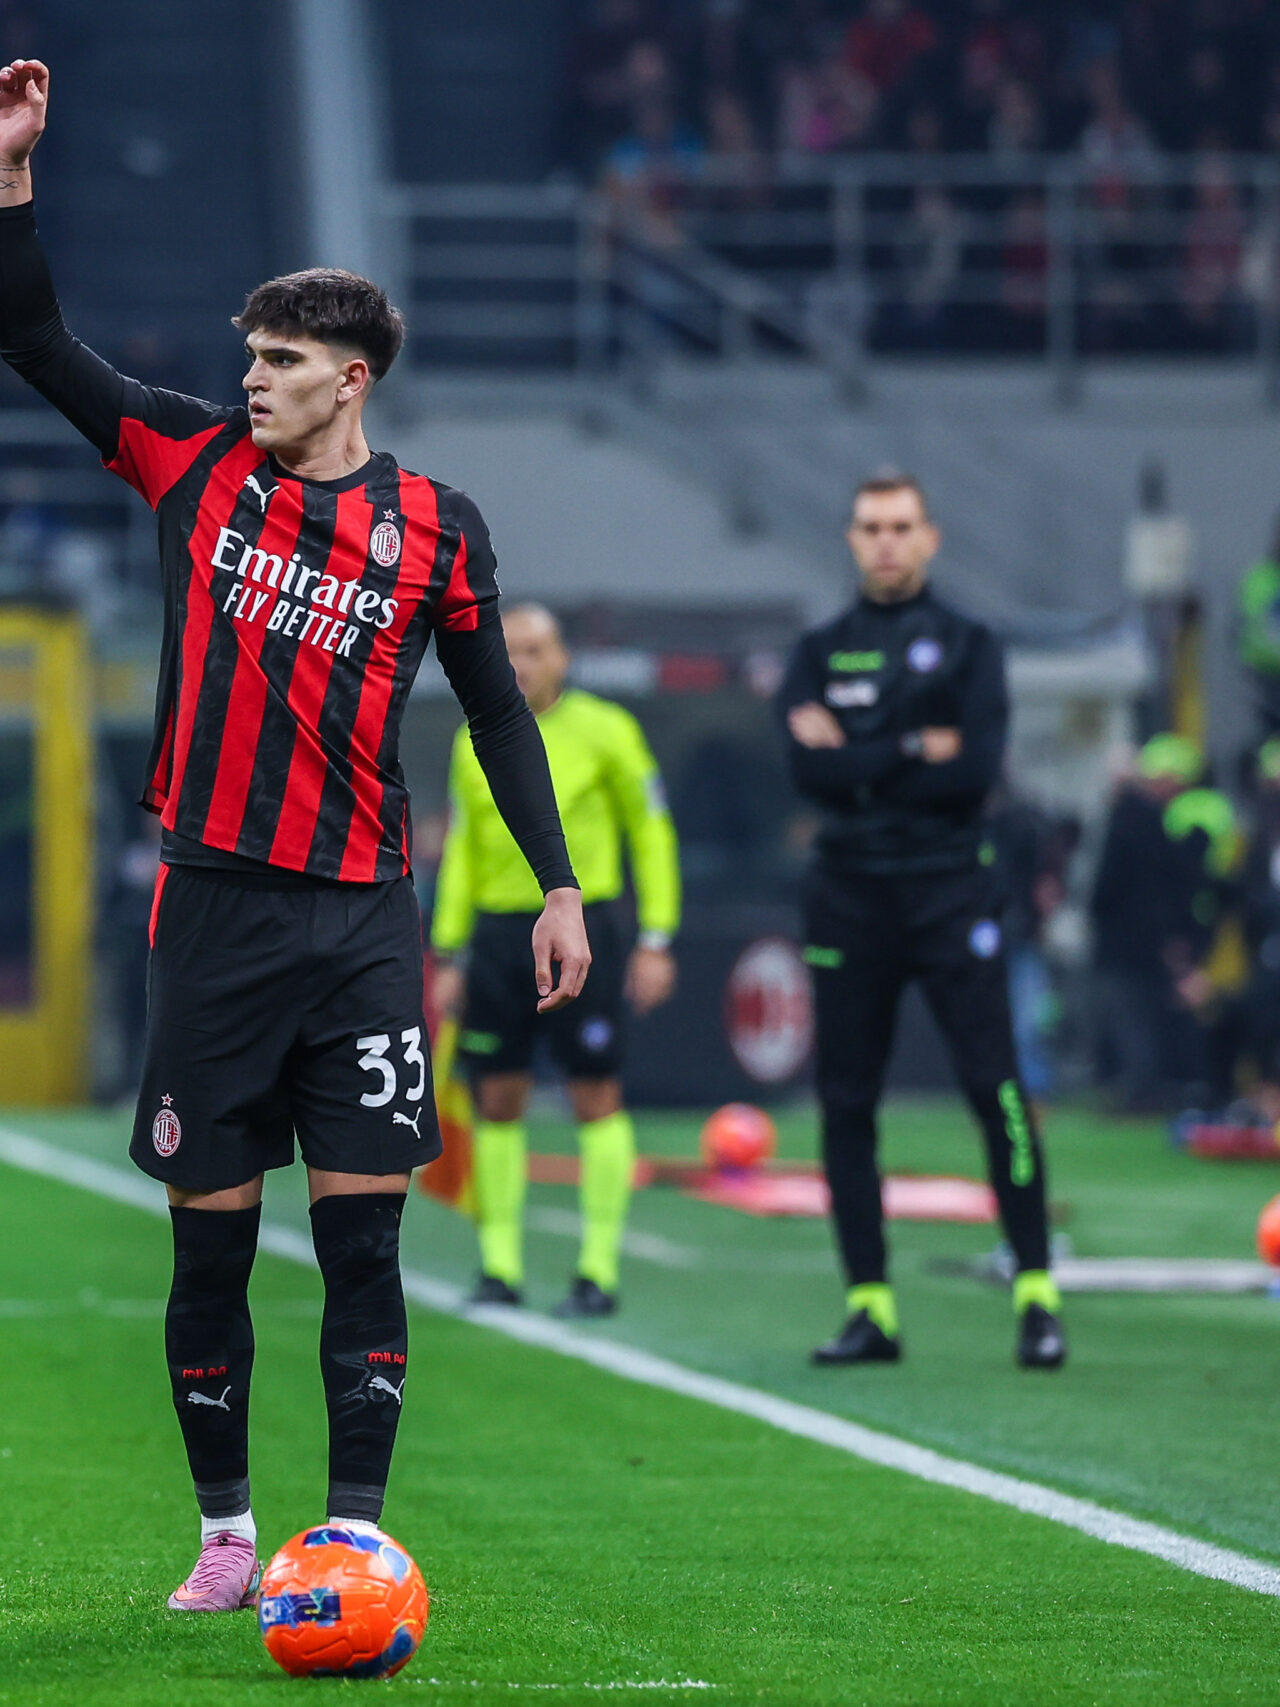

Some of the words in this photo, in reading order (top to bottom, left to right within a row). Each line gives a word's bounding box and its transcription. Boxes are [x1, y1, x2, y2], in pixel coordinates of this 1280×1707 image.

[211, 526, 399, 629] Emirates
[222, 583, 269, 622] FLY
[266, 600, 360, 658] BETTER
[356, 1026, 425, 1108] 33
